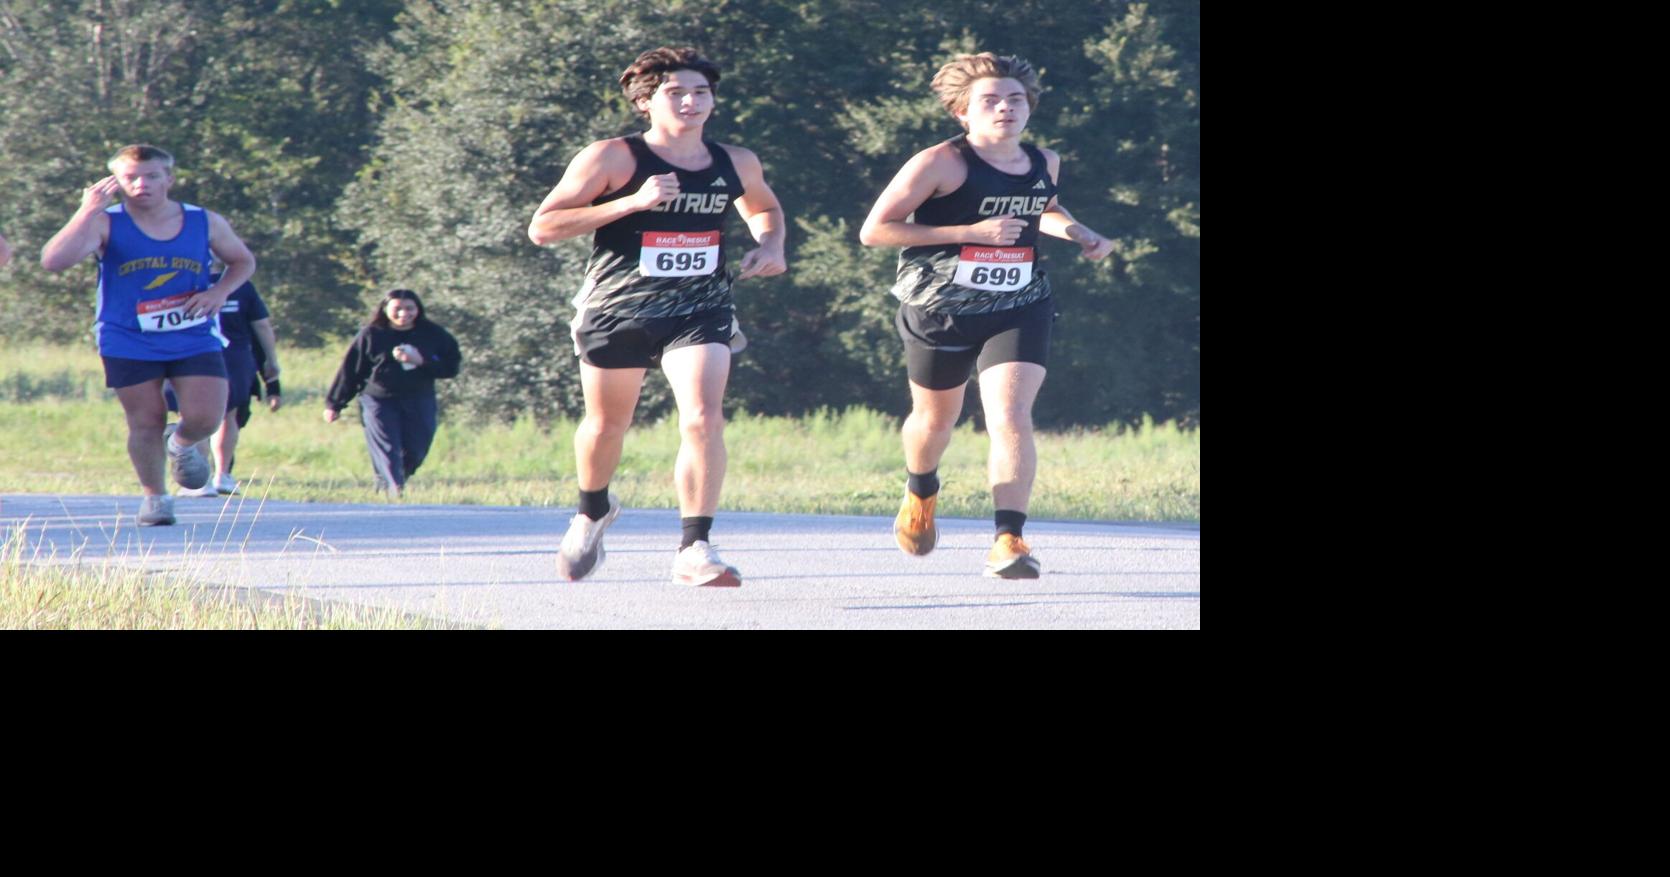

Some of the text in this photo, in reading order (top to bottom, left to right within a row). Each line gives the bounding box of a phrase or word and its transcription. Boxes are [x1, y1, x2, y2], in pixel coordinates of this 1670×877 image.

[978, 196, 1048, 215] CITRUS
[119, 256, 167, 276] CRYSTAL
[656, 252, 706, 271] 695
[970, 266, 1021, 286] 699
